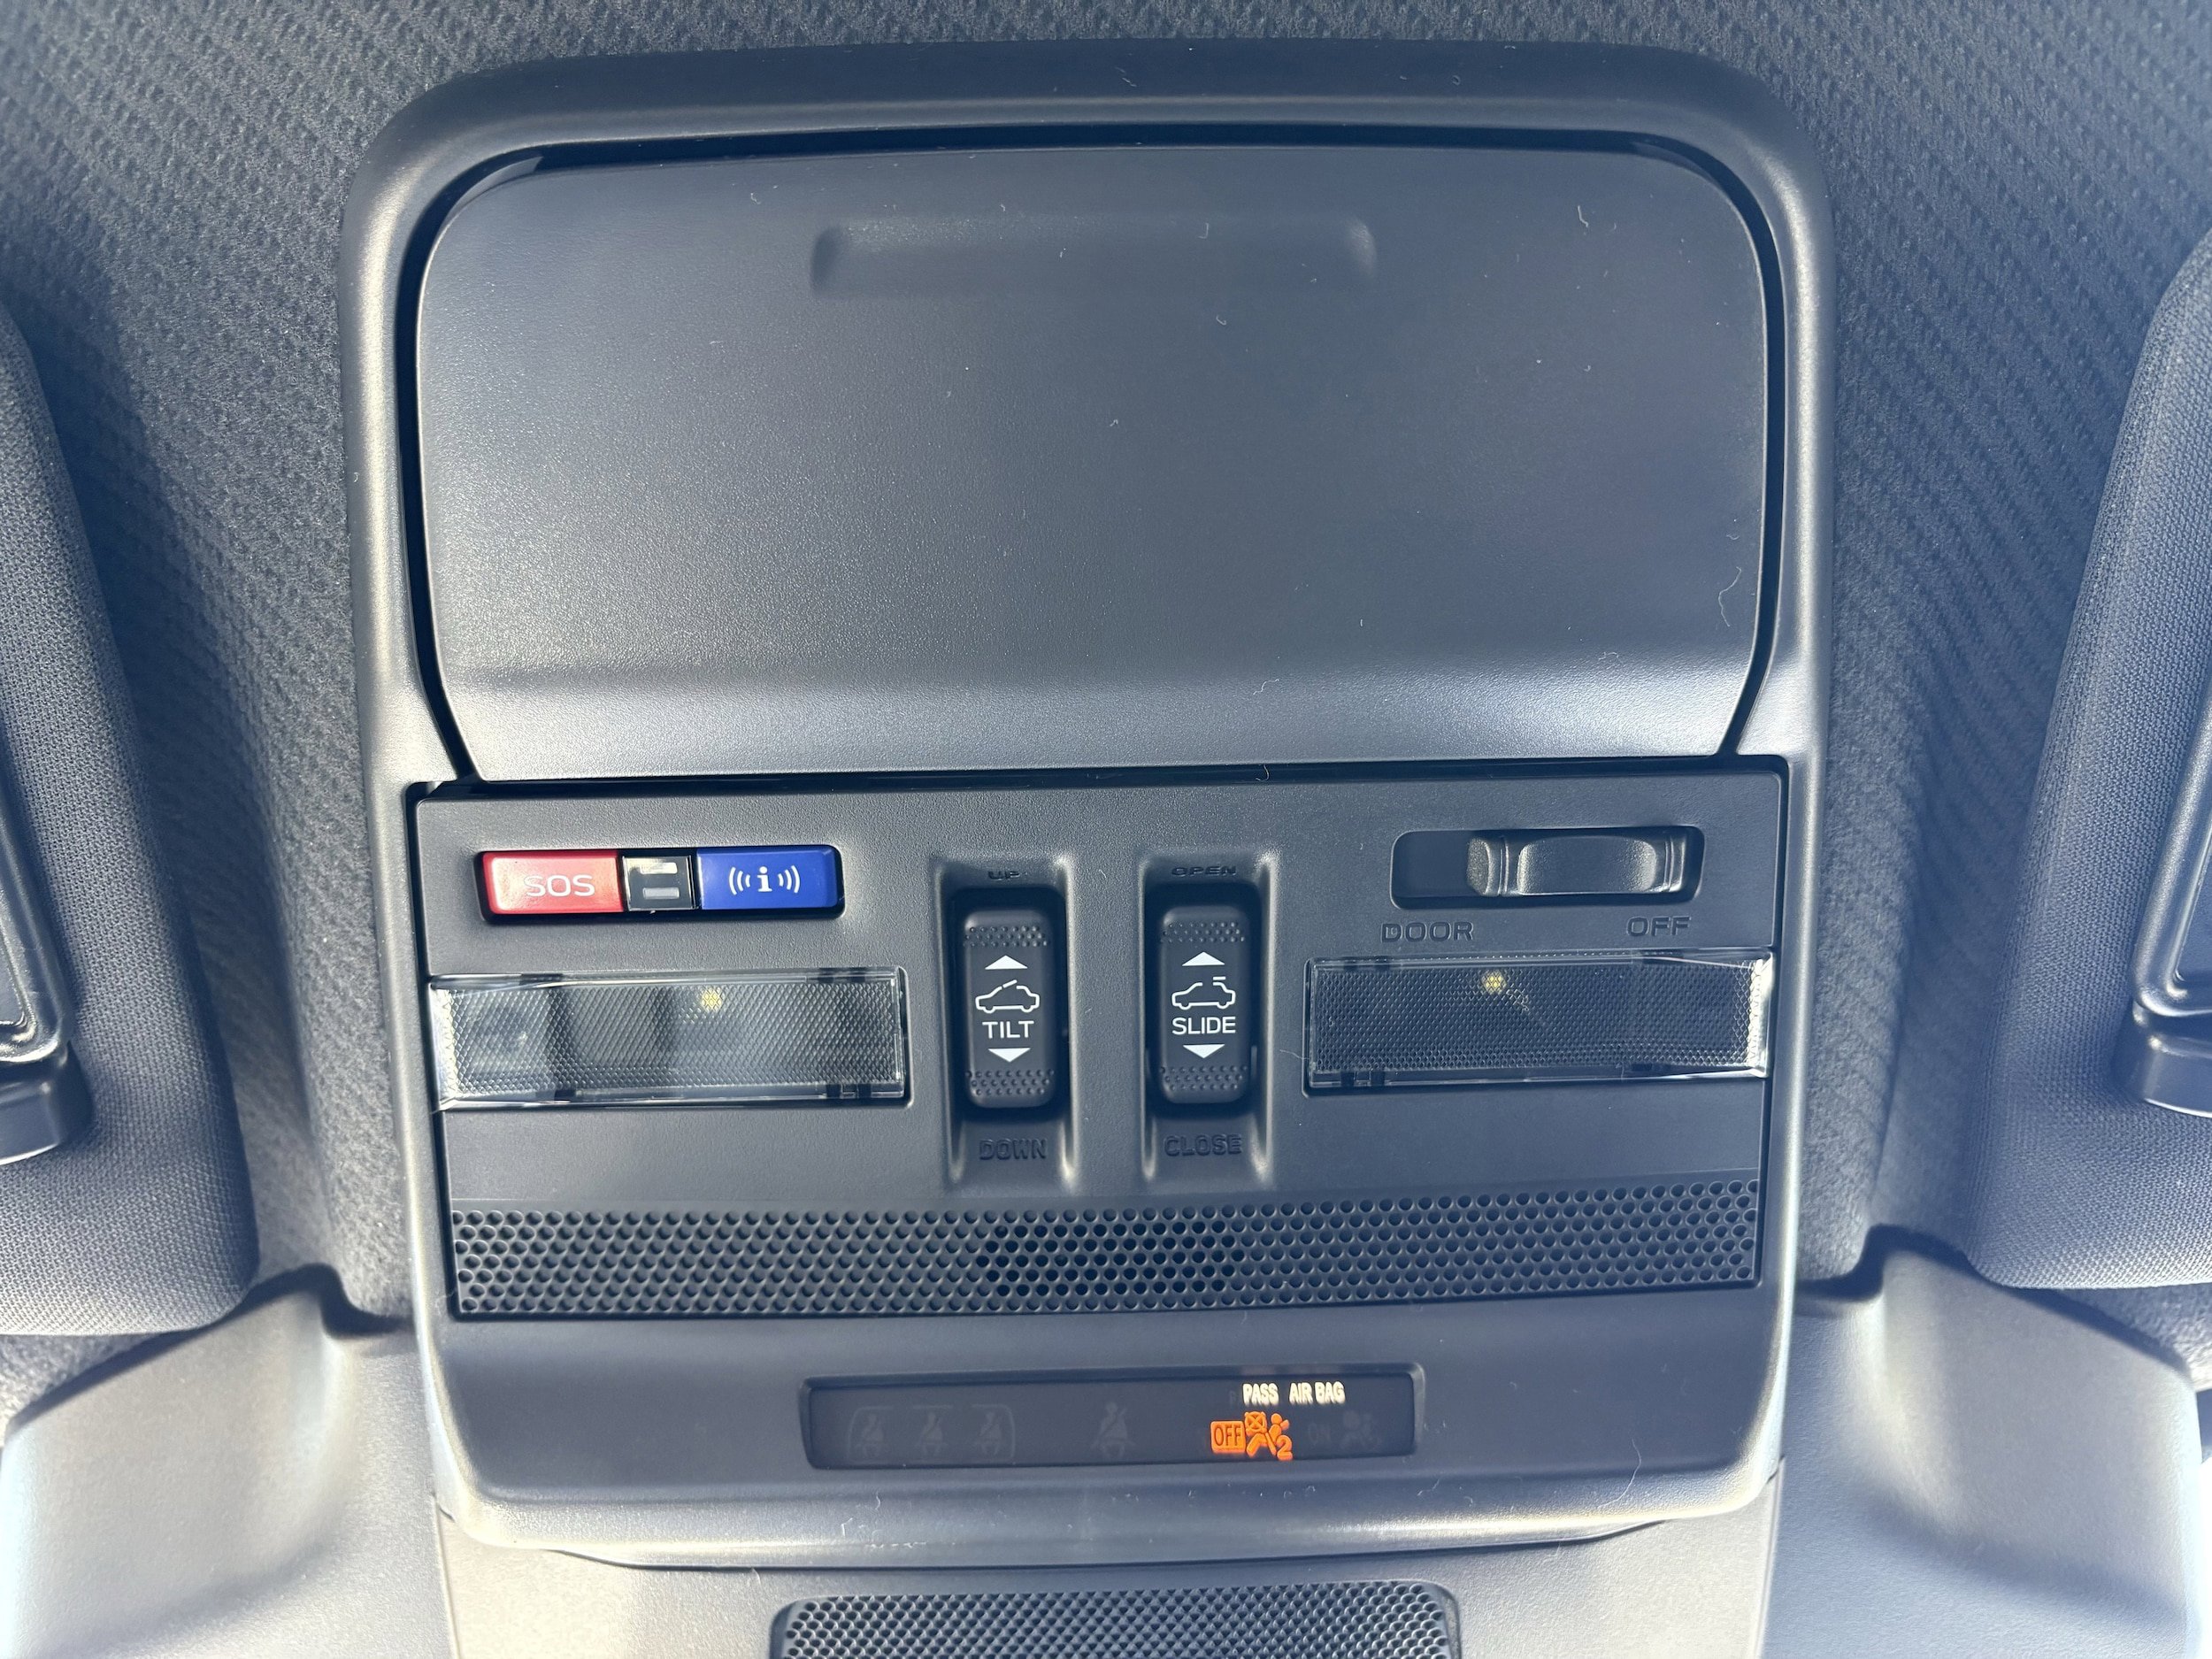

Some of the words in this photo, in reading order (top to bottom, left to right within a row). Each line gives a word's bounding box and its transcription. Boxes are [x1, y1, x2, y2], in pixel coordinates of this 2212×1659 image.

[987, 870, 1022, 880] UP
[1171, 865, 1237, 877] OPEN
[525, 874, 595, 897] SOS
[1380, 921, 1474, 943] DOOR
[1626, 916, 1692, 938] OFF
[982, 1020, 1034, 1039] TILT
[1171, 1017, 1236, 1035] SLIDE
[979, 1138, 1048, 1161] DOWN
[1164, 1134, 1242, 1157] CLOSE
[1242, 1383, 1279, 1404] PASS
[1289, 1382, 1313, 1404] AIR
[1314, 1381, 1346, 1404] BAG
[1213, 1425, 1242, 1447] OFF
